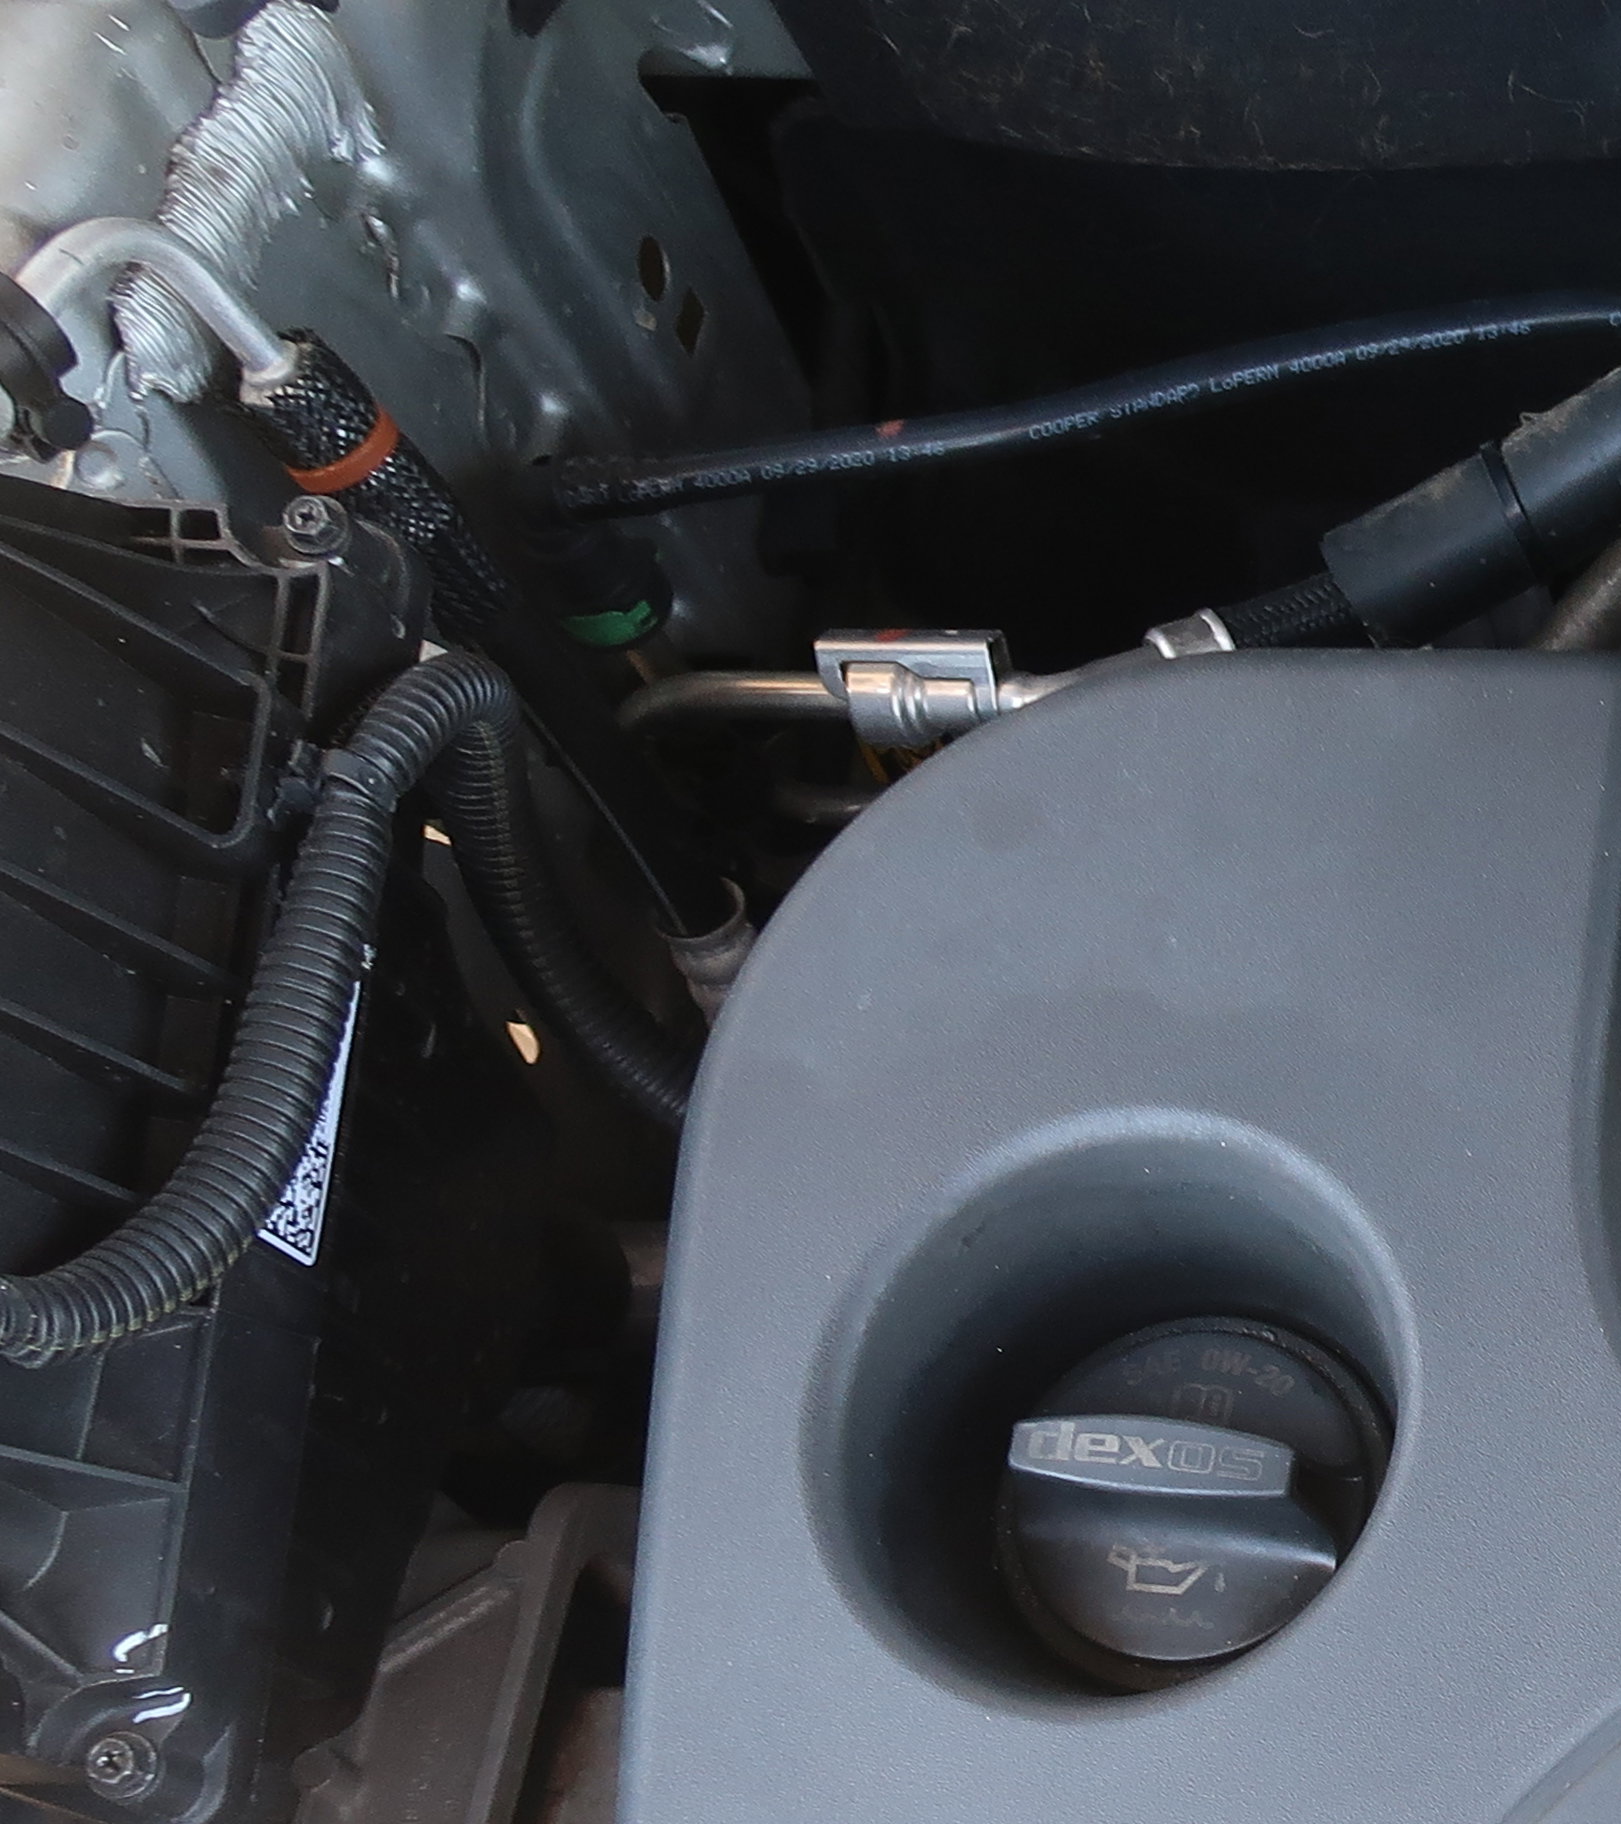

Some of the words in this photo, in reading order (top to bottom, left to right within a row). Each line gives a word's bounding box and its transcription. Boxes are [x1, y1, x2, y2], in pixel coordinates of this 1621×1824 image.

[1028, 410, 1100, 440] COOPER
[1109, 382, 1200, 419] STANDARD
[1122, 1350, 1183, 1386] SAE
[1028, 1422, 1266, 1480] dexos
